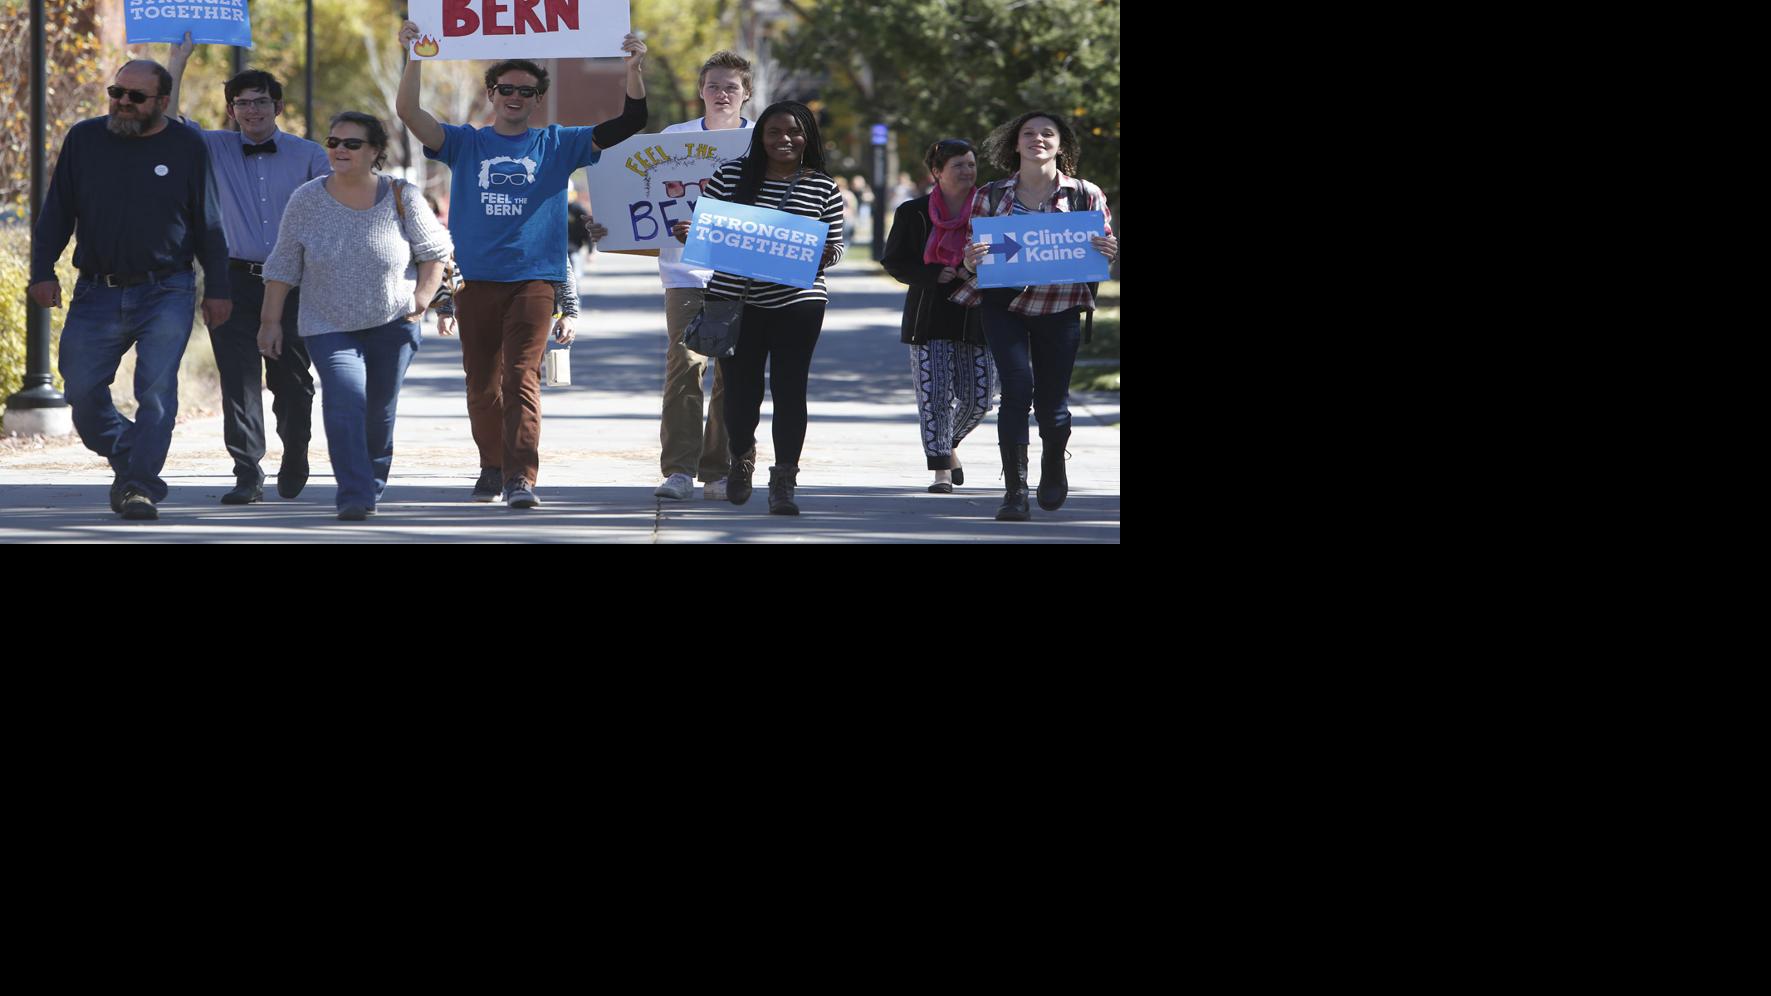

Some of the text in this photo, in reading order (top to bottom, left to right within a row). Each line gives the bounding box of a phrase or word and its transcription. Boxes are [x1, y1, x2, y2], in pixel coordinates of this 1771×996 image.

[130, 6, 245, 22] TOGETHER
[442, 0, 580, 37] BERN
[625, 143, 718, 177] FEEL THE
[480, 192, 512, 204] FEEL
[485, 203, 523, 216] BERN
[698, 212, 819, 247] STRONGER
[1022, 228, 1100, 246] Clinton
[696, 226, 815, 262] TOGETHER
[1025, 245, 1087, 262] Kaine
